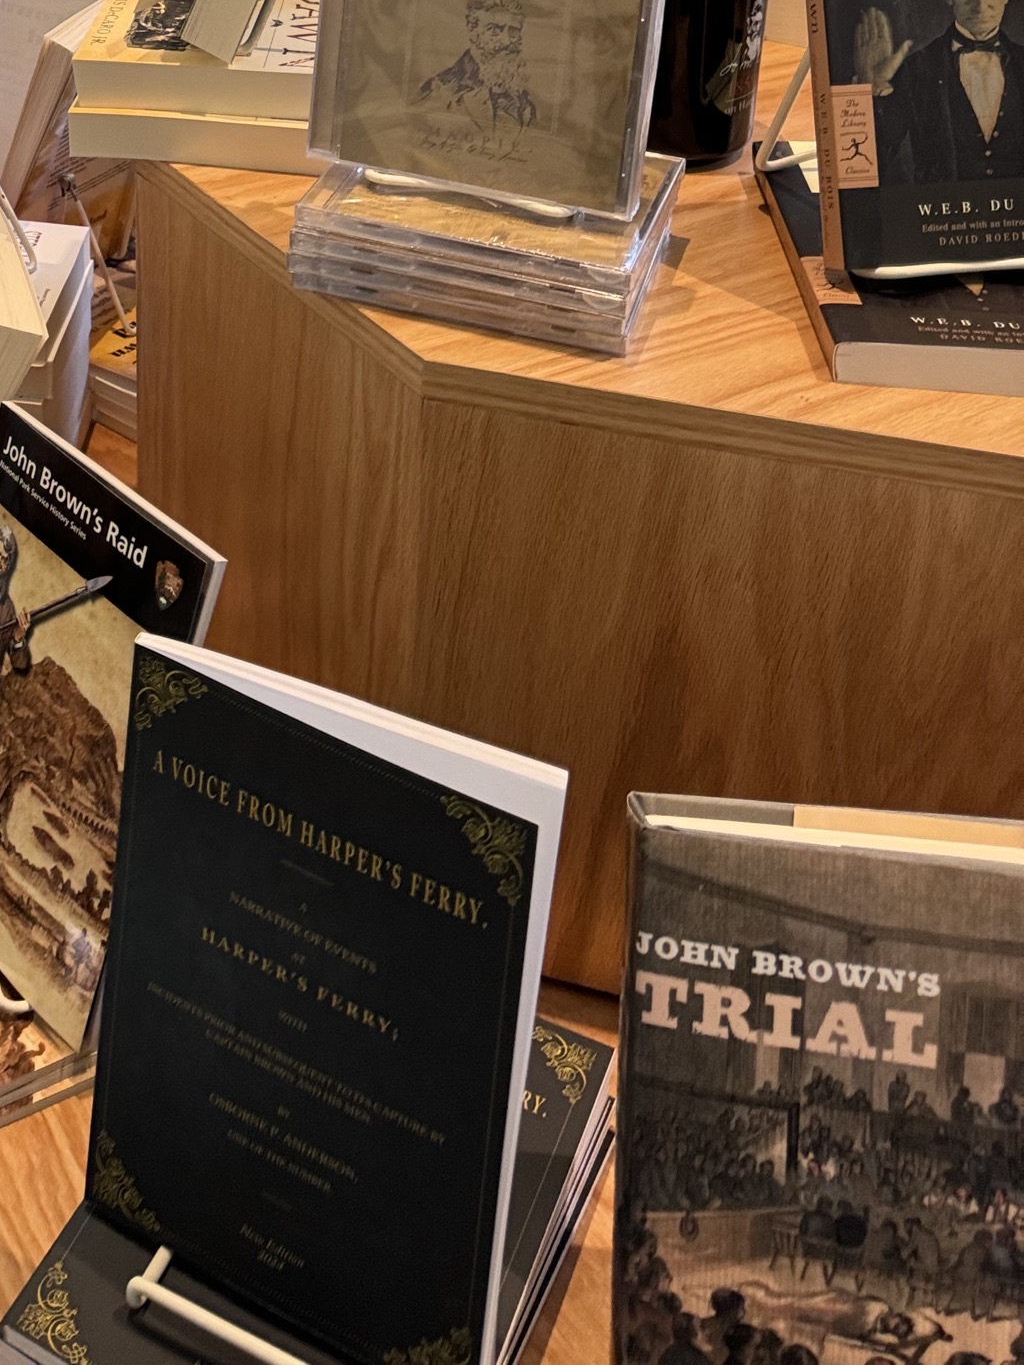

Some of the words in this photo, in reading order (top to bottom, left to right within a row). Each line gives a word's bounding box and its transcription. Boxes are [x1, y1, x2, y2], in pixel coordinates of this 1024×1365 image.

[845, 99, 859, 108] The
[840, 109, 866, 118] Modern
[840, 119, 867, 129] Library
[845, 166, 870, 175] Classics
[918, 201, 979, 216] W.E.B.
[990, 198, 1014, 212] DU
[922, 223, 948, 233] Edited
[951, 222, 966, 230] and
[969, 221, 987, 229] with
[1003, 219, 1024, 227] Intro
[939, 234, 978, 246] DAVID
[993, 321, 1021, 330] DU
[0, 460, 19, 484] National
[19, 477, 31, 492] Park
[30, 488, 49, 509] Service
[50, 505, 69, 527] History
[70, 522, 87, 540] Series
[2, 436, 36, 479] John
[40, 466, 105, 533] Brown's
[105, 520, 149, 569] Raid
[153, 750, 165, 774] A
[171, 756, 230, 807] VOICE
[236, 790, 293, 837] FROM
[301, 820, 402, 890] HARPER'S
[410, 872, 490, 930] FERRY.
[202, 926, 309, 993] HARPER'S
[635, 931, 739, 972] JOHN
[751, 948, 942, 998] BROWN'S
[634, 970, 940, 1070] TRIAL
